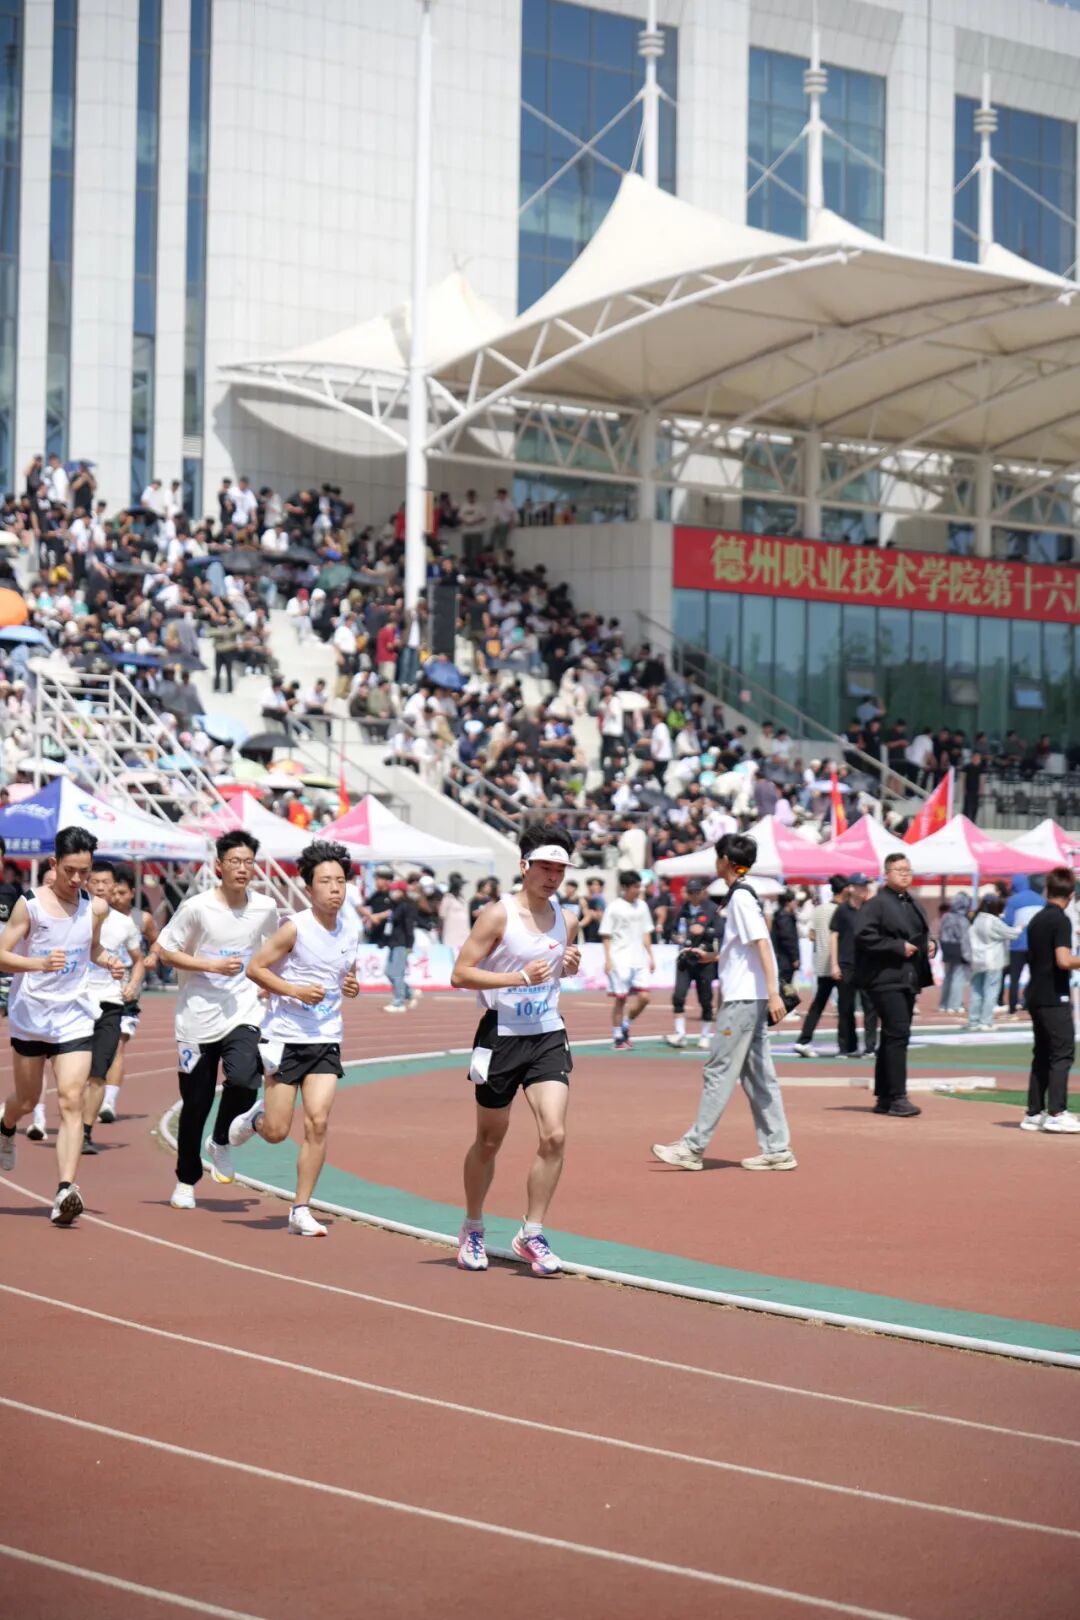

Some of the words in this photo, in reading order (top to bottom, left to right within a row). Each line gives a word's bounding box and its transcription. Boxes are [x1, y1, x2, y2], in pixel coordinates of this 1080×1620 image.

[711, 533, 1080, 614] 德州职业技术学院第十六
